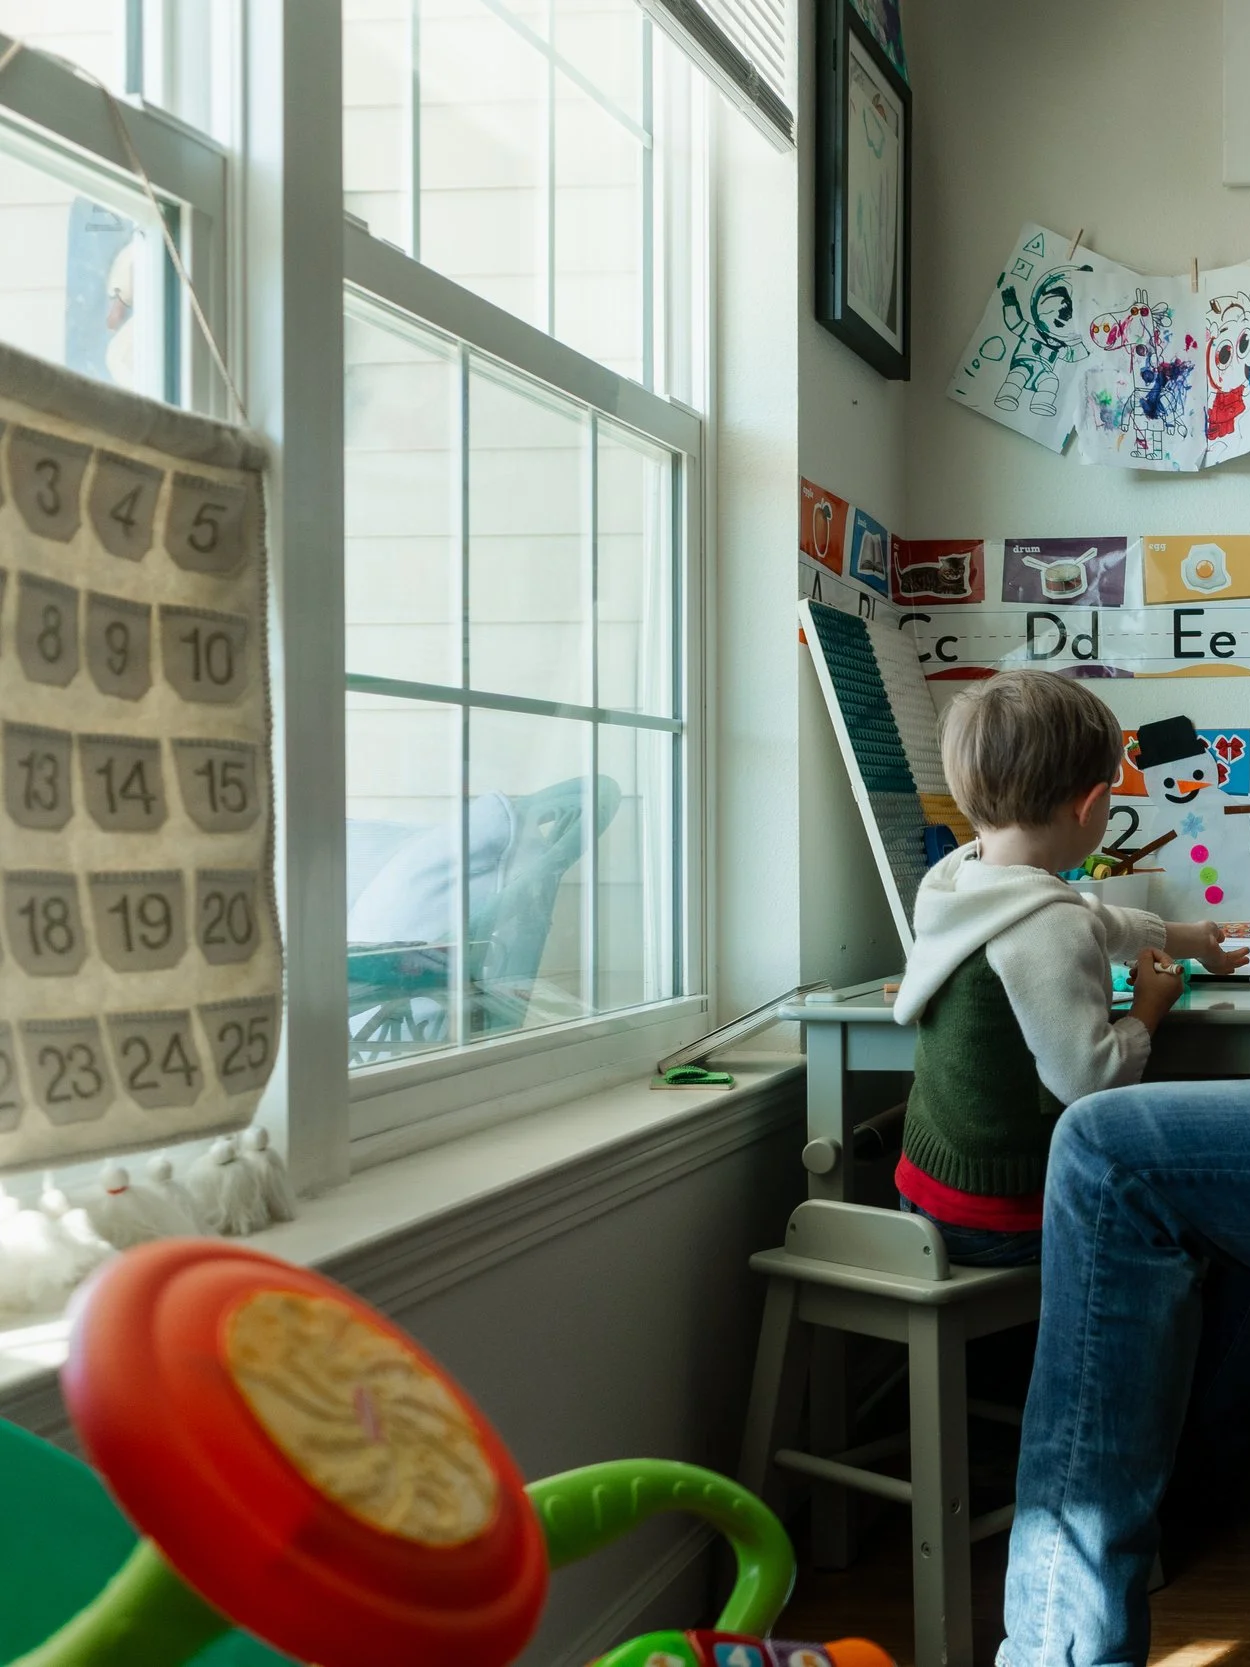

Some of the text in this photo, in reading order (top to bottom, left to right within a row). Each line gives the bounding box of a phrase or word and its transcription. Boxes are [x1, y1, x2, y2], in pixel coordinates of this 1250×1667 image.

[35, 457, 227, 553] 3 4 5
[1012, 545, 1041, 553] drum
[1148, 543, 1167, 552] egg
[36, 603, 235, 686] 8 9 10
[1026, 611, 1099, 660] Dd
[1173, 608, 1237, 658] Ee
[18, 749, 249, 815] 13 14 15
[17, 890, 255, 957] 18 19 20
[37, 1042, 103, 1106] 23
[120, 1031, 200, 1092] 24
[217, 1015, 271, 1078] 25
